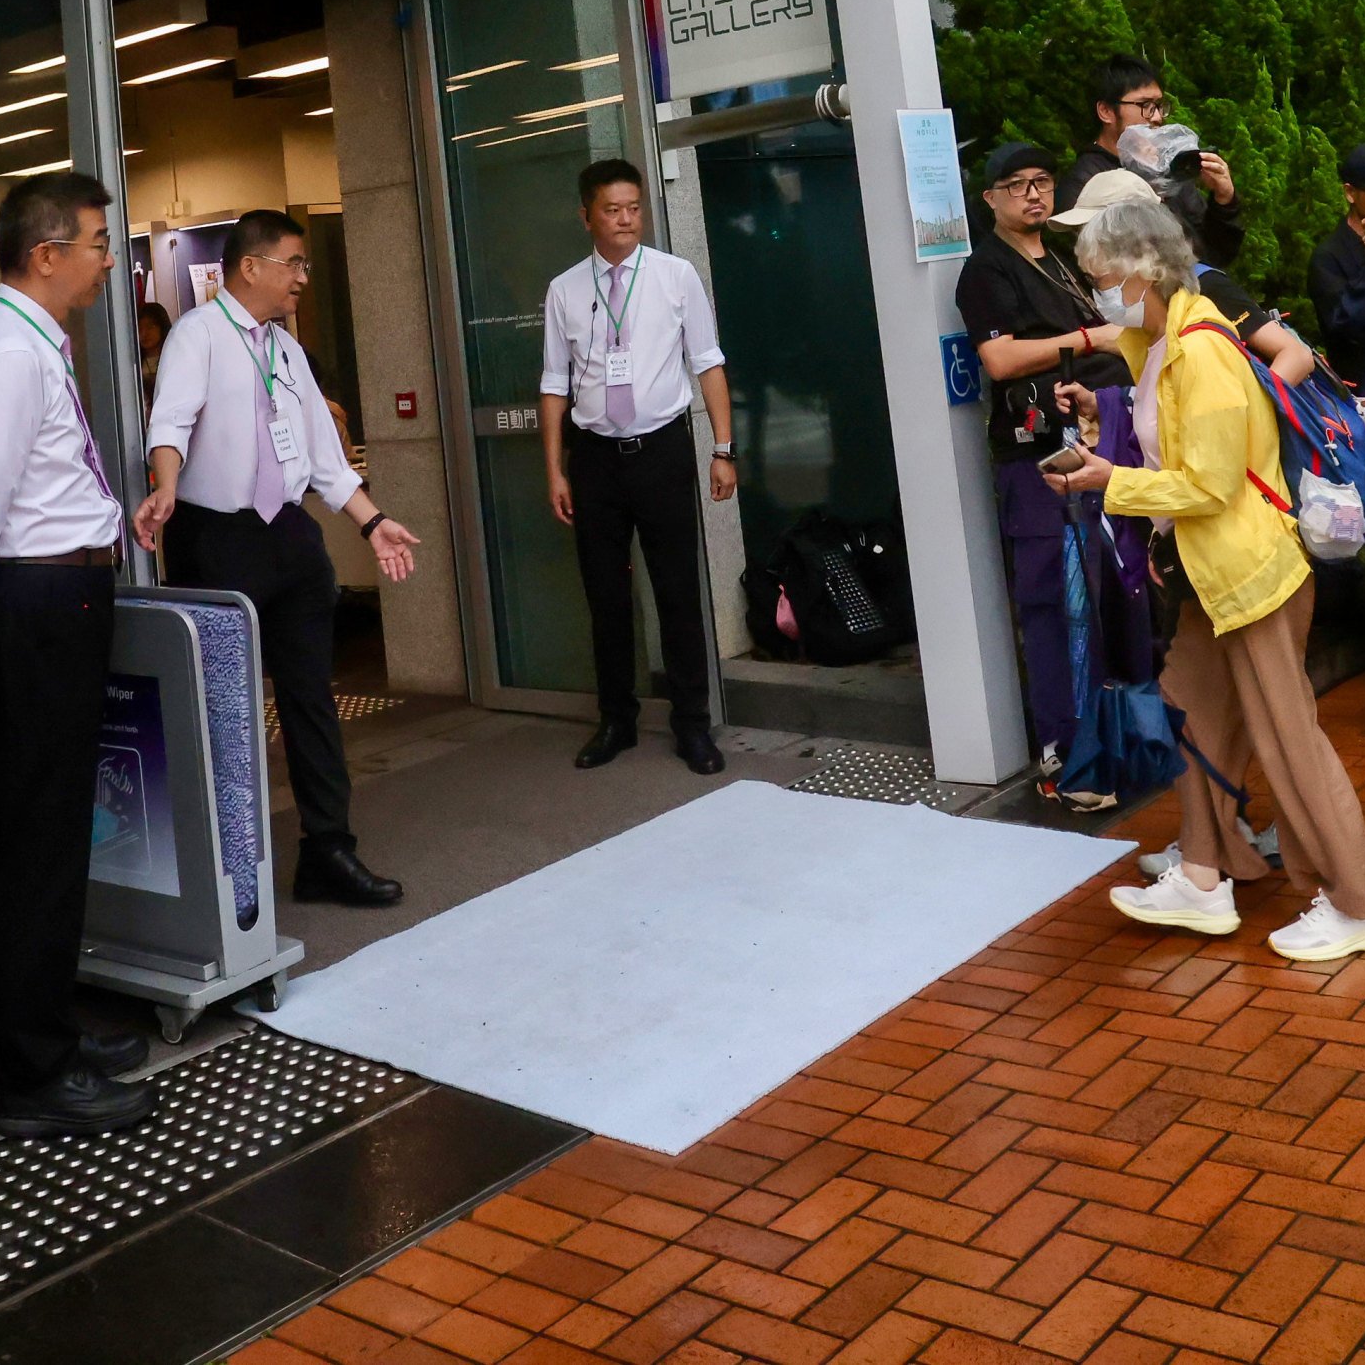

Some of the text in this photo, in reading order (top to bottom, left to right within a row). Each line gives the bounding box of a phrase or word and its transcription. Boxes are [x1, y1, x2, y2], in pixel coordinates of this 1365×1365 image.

[496, 408, 538, 430] 自動門
[106, 685, 135, 702] Wiper
